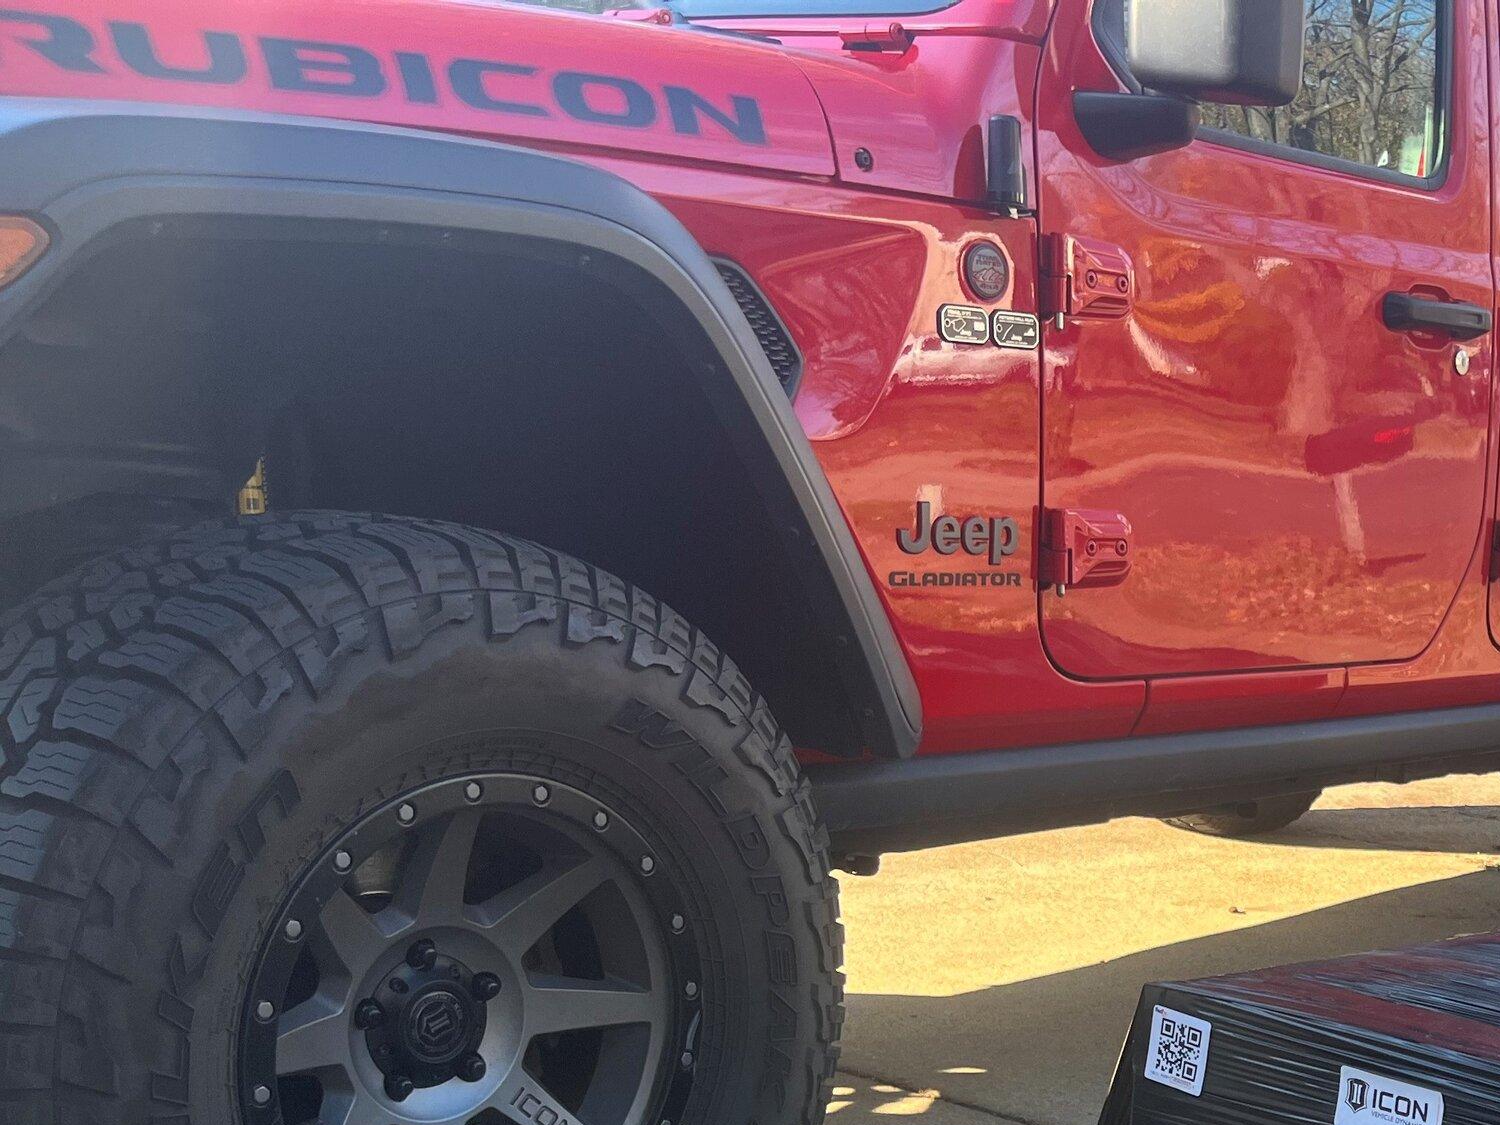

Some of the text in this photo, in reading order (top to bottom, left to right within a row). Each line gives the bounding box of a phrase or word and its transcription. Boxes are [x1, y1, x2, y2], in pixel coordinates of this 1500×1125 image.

[0, 9, 767, 146] RUBICON
[895, 501, 1020, 565] Jeep
[888, 571, 1022, 587] GLADIATOR
[1371, 1110, 1394, 1123] VEHICLE
[1372, 1088, 1429, 1123] ICON
